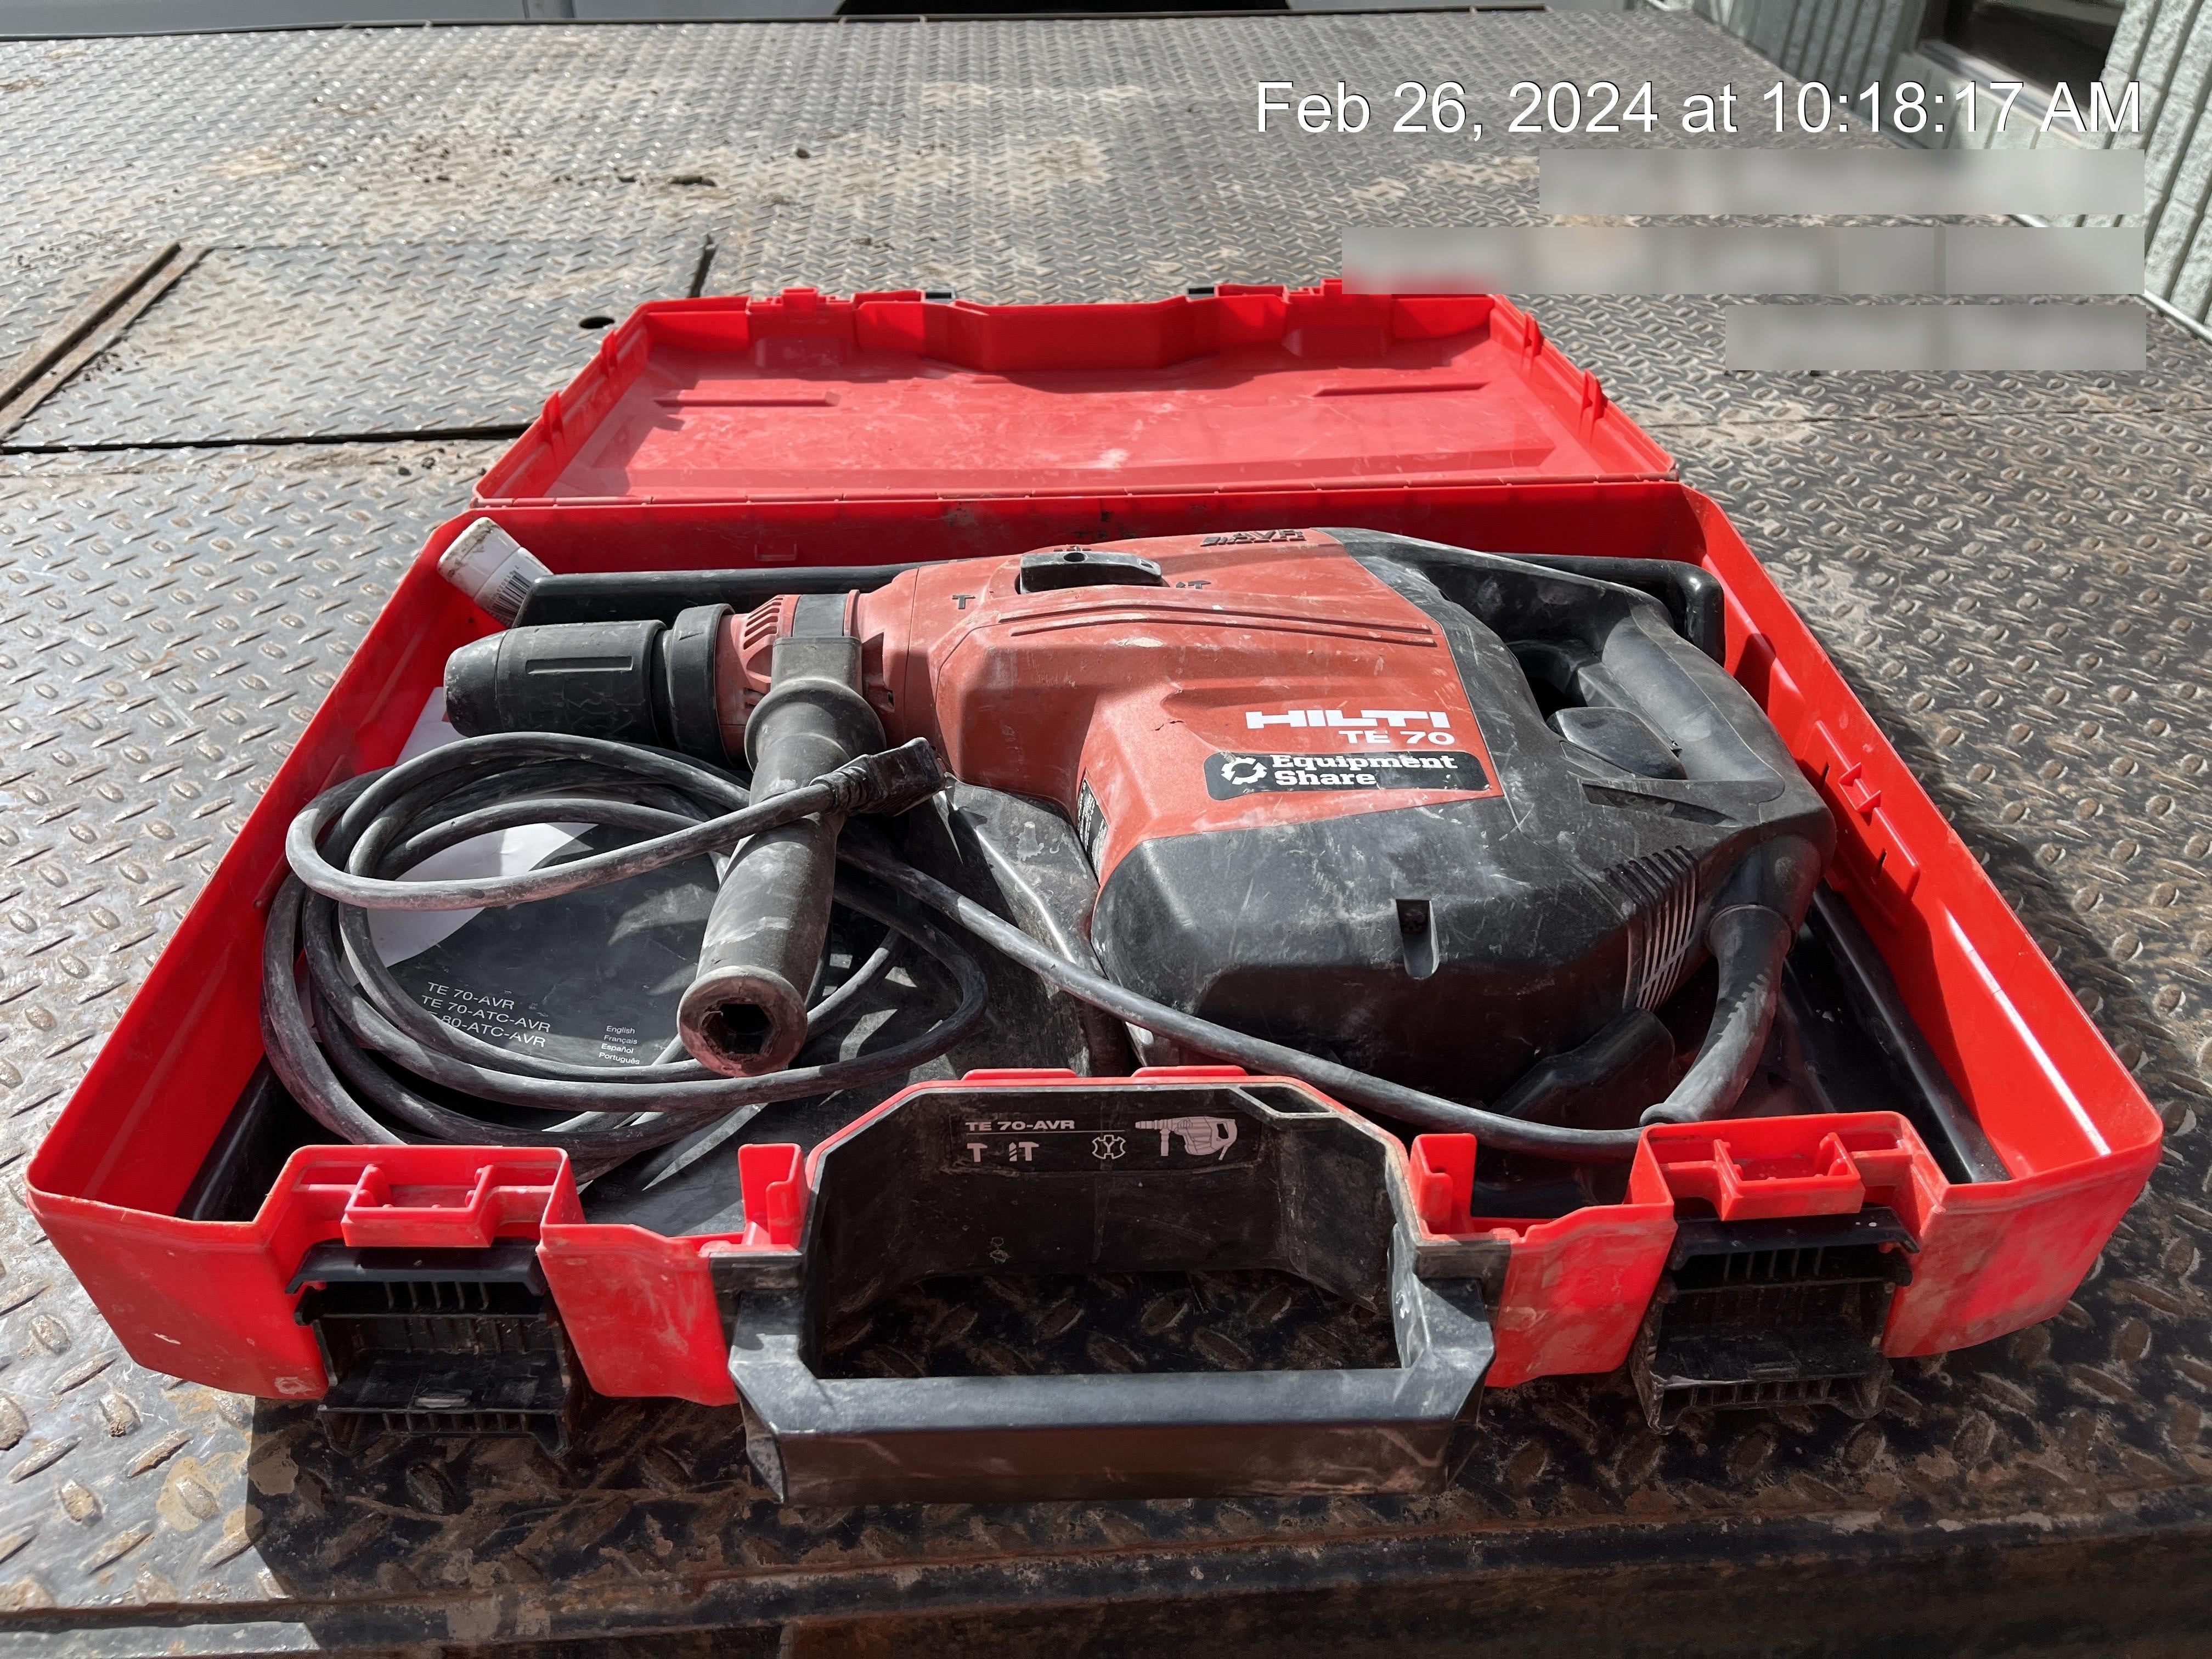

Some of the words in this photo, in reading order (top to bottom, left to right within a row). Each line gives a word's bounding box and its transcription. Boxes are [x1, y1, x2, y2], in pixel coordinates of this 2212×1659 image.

[1245, 709, 1451, 729] HILTI
[1338, 730, 1391, 744] TE
[1400, 731, 1455, 745] 70
[1270, 754, 1458, 771] Equipment
[1274, 770, 1378, 786] Share
[428, 981, 449, 996] TE
[454, 988, 515, 1010] 70-AVR
[421, 995, 443, 1008] TE
[448, 1002, 551, 1033] 70-ATC-AVR
[606, 1025, 635, 1034] English
[603, 1035, 637, 1045] Français
[601, 1043, 634, 1054] Español
[599, 1052, 640, 1065] Português
[965, 1122, 992, 1131] TE
[997, 1120, 1075, 1131] 70-AVR
